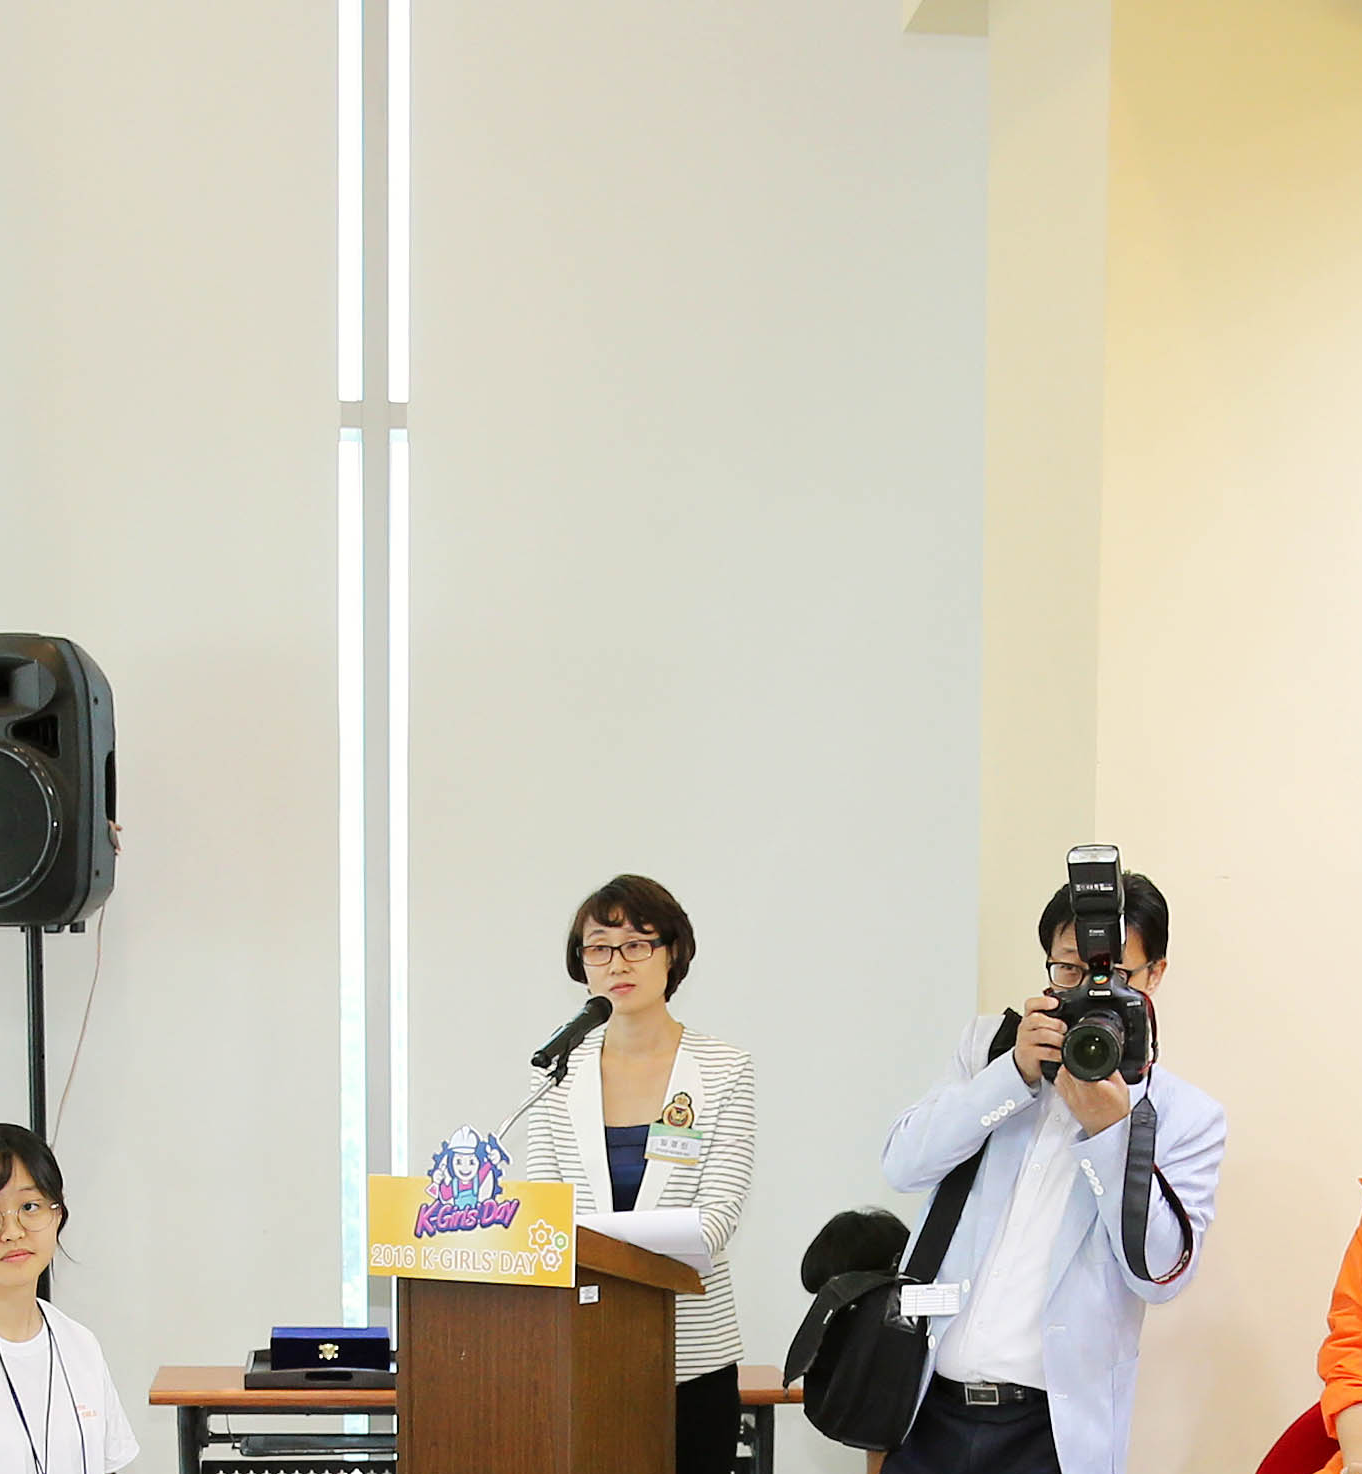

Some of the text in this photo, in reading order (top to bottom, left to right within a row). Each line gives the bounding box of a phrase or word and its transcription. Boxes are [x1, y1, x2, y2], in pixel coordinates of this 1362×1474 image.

[370, 1244, 539, 1275] 2016 K-GIRLS' DAY
